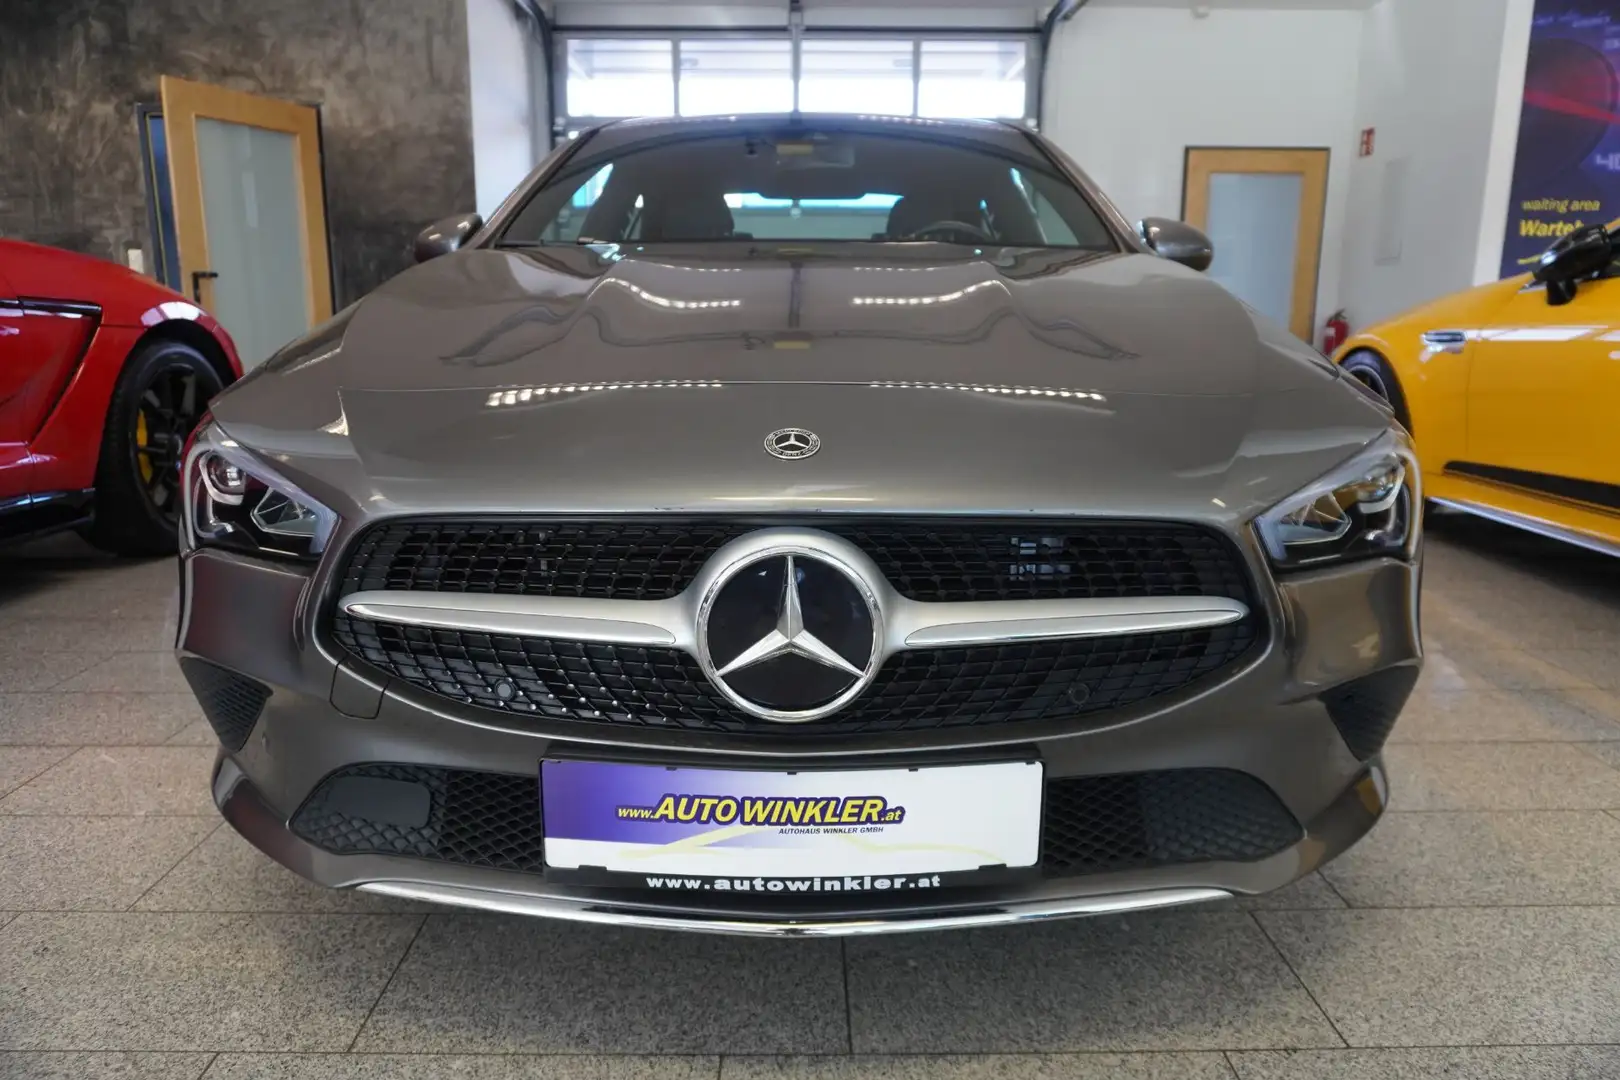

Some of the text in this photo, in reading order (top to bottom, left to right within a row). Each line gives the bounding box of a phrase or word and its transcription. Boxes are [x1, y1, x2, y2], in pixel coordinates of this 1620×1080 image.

[1523, 198, 1601, 213] waiting area
[779, 827, 821, 835] AUTOHAUS
[860, 826, 884, 834] GMBH
[646, 875, 940, 892] www.autowinkler.at
